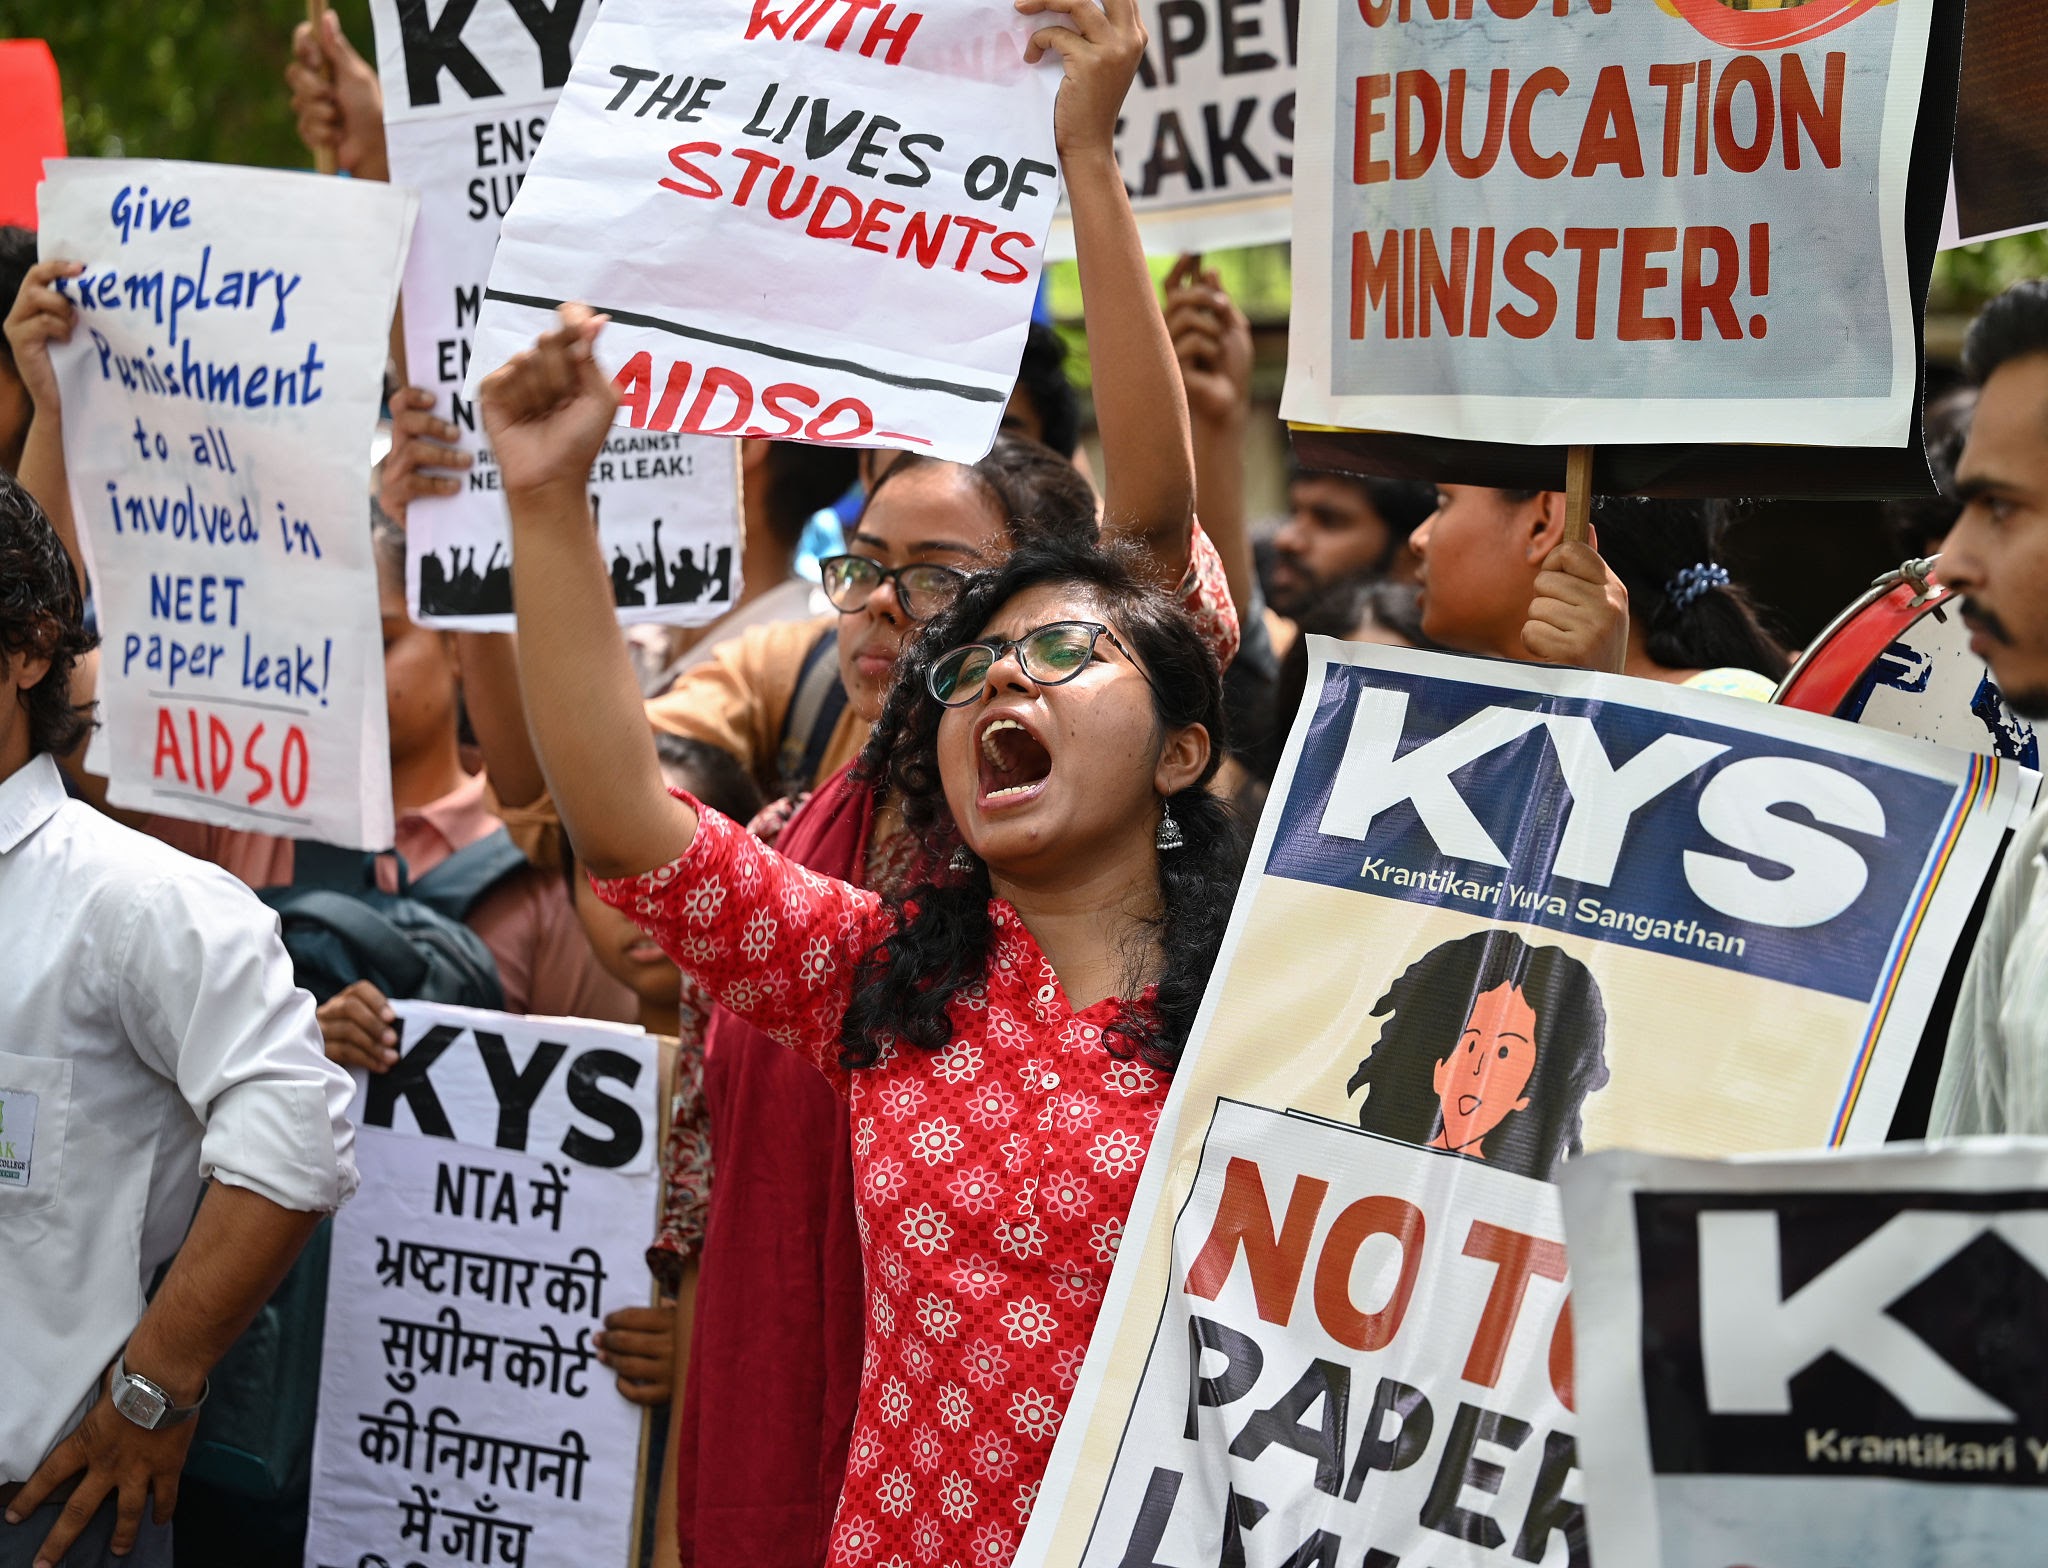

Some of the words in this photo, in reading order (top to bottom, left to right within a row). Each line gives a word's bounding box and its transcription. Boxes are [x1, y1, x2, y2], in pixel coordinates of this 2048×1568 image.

[744, 0, 924, 66] WITH
[604, 64, 727, 123] THE
[741, 82, 945, 188] LIVES
[963, 153, 1057, 212] OF
[1113, 90, 1296, 198] AKS
[1353, 51, 1846, 185] EDUCATION
[111, 185, 191, 245] Give
[657, 141, 1037, 285] STUDENTS
[1349, 221, 1769, 342] MINISTER!
[89, 338, 325, 408] Punishment
[133, 418, 169, 461] to
[189, 426, 236, 474] all
[622, 455, 694, 480] LEAK!
[106, 482, 259, 546] involved
[276, 501, 322, 560] in
[149, 573, 245, 628] NEET
[123, 633, 224, 688] paper
[241, 632, 332, 707] leak!
[152, 706, 310, 809] AIDSO
[1317, 687, 1887, 930] KYS
[1360, 856, 1503, 905] Krantikari
[1508, 882, 1567, 917] Yuva
[1575, 896, 1746, 958] Sangathan
[363, 1017, 643, 1169] KYS
[435, 1161, 518, 1226] NTA
[529, 1161, 571, 1232] में
[376, 1235, 540, 1308] भ्रष्टाचार
[544, 1247, 608, 1319] की
[1183, 1156, 1426, 1351] NO
[378, 1306, 500, 1394] सुप्रीम
[503, 1324, 597, 1398] कोर्ट
[358, 1399, 420, 1471] की
[423, 1407, 591, 1501] निगरानी
[1183, 1315, 1592, 1568] PAPER
[1805, 1428, 2017, 1473] Krantikari
[398, 1484, 438, 1552] में
[440, 1493, 534, 1568] जाँच
